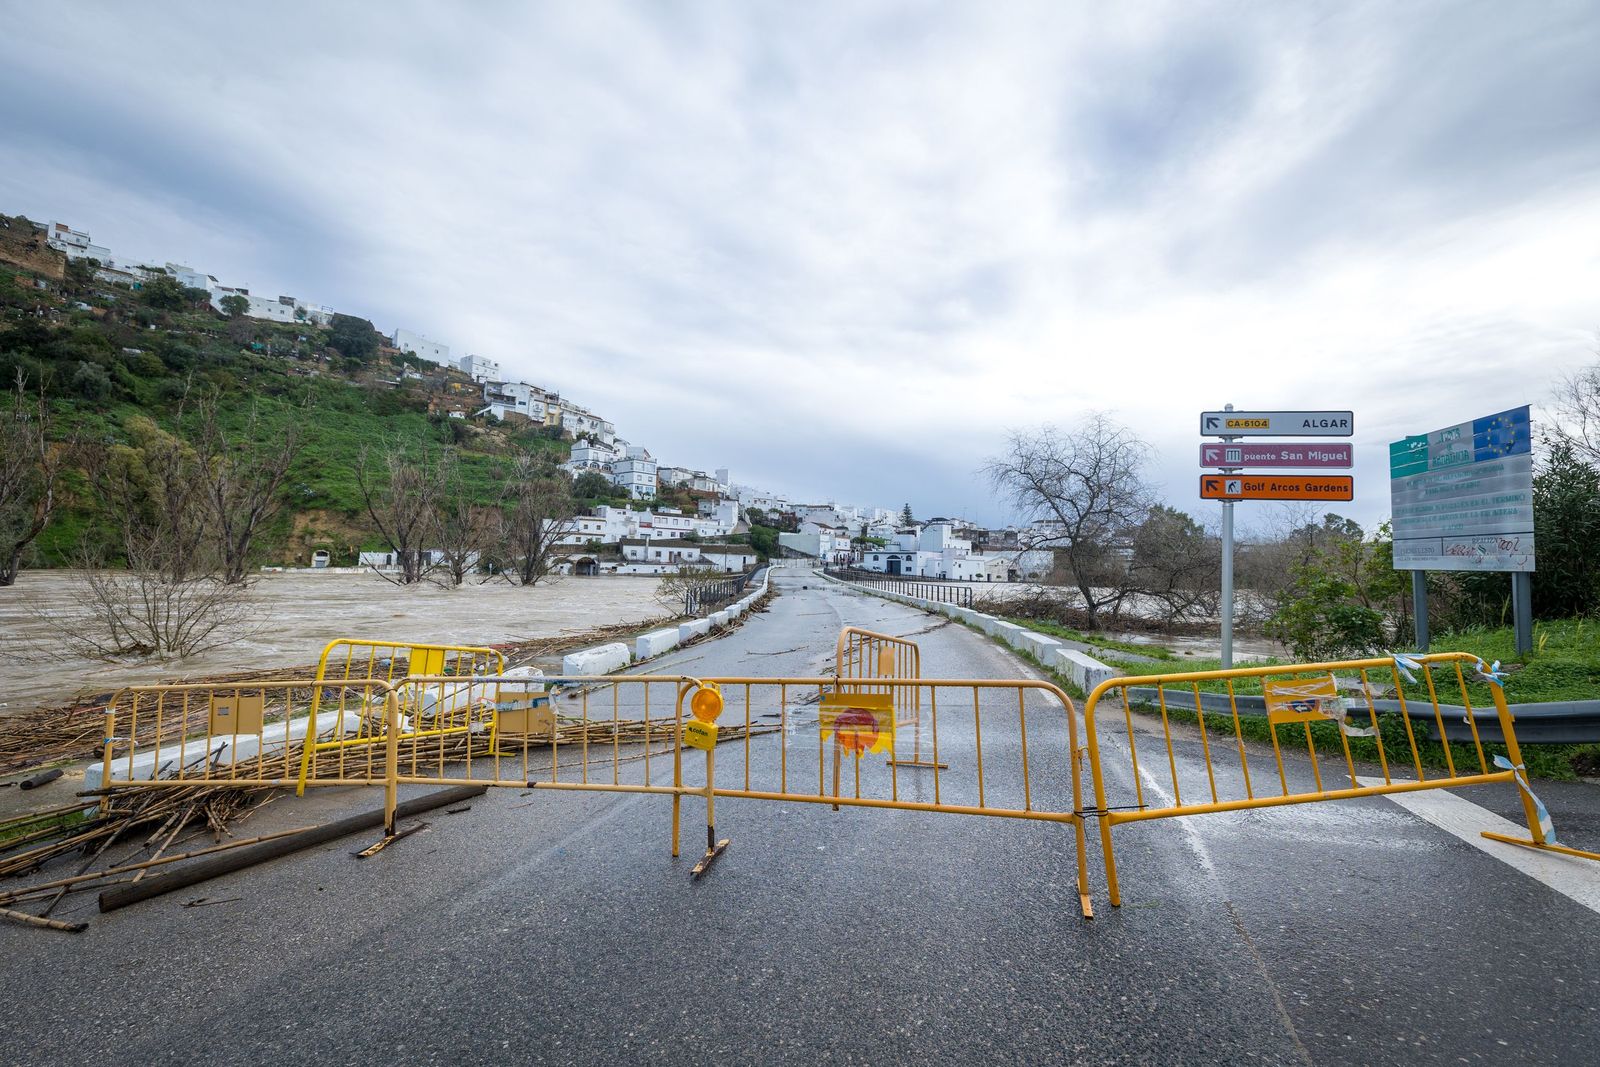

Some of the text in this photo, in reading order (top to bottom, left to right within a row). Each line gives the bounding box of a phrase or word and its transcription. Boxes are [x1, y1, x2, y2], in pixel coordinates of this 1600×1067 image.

[1227, 419, 1268, 428] CA-6104
[1302, 419, 1348, 428] ALGAR
[1244, 451, 1347, 461] puente San Miguel
[1244, 483, 1348, 492] Golf Arcos Gardens
